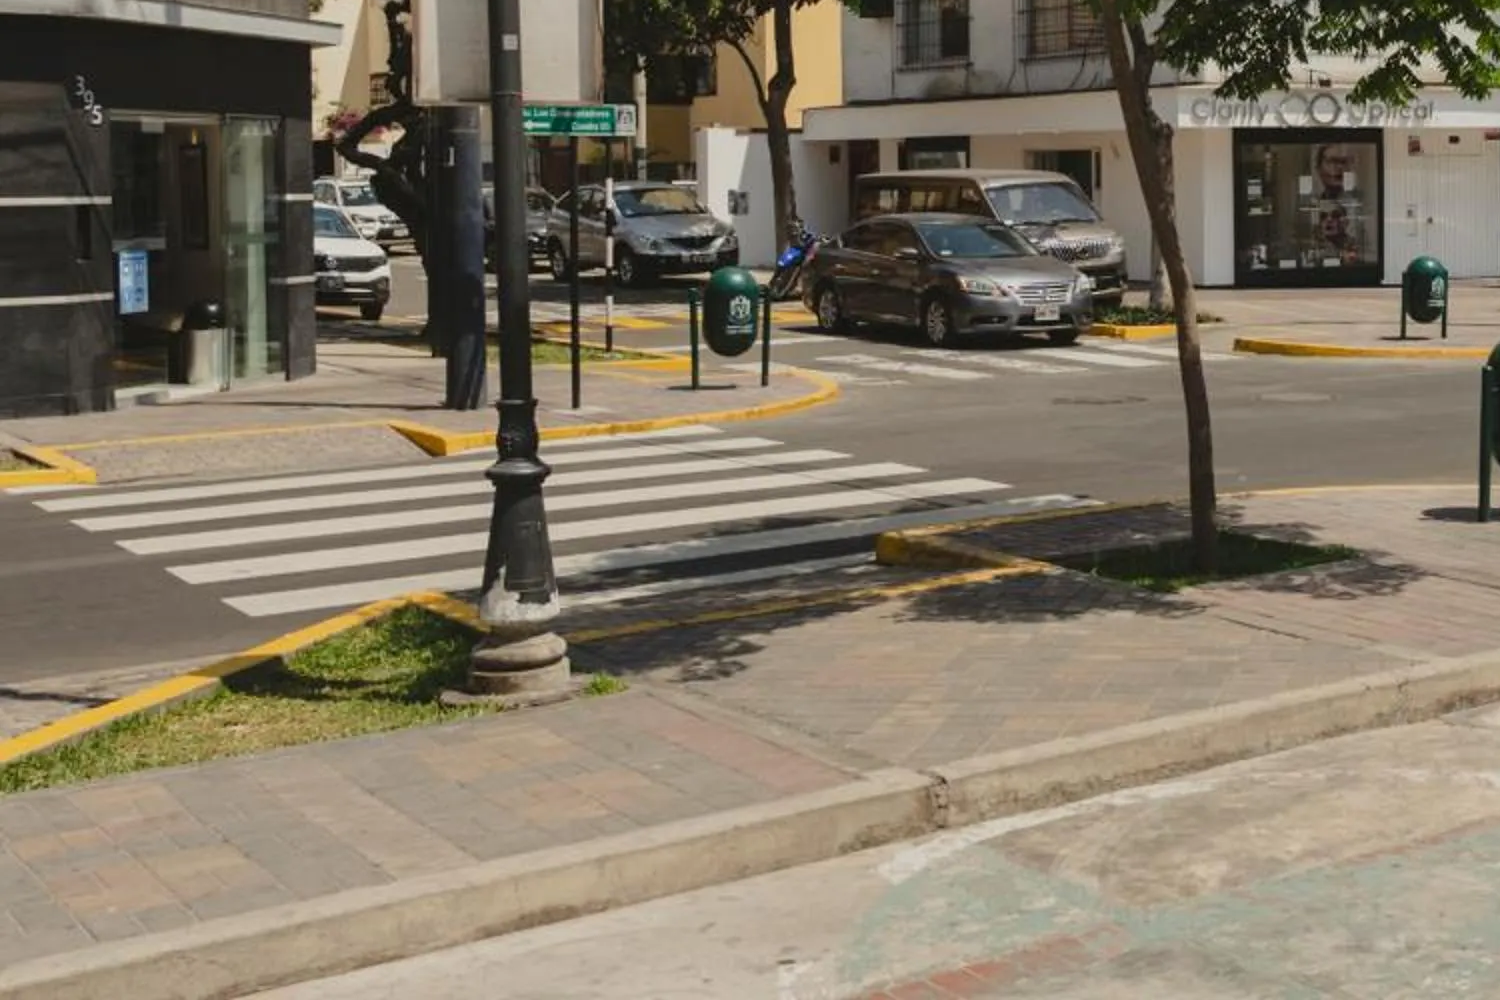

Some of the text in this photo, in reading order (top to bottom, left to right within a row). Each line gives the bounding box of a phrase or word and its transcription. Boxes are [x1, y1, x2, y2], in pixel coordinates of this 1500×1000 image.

[75, 75, 103, 125] 395
[1190, 97, 1434, 126] Clarity Optical
